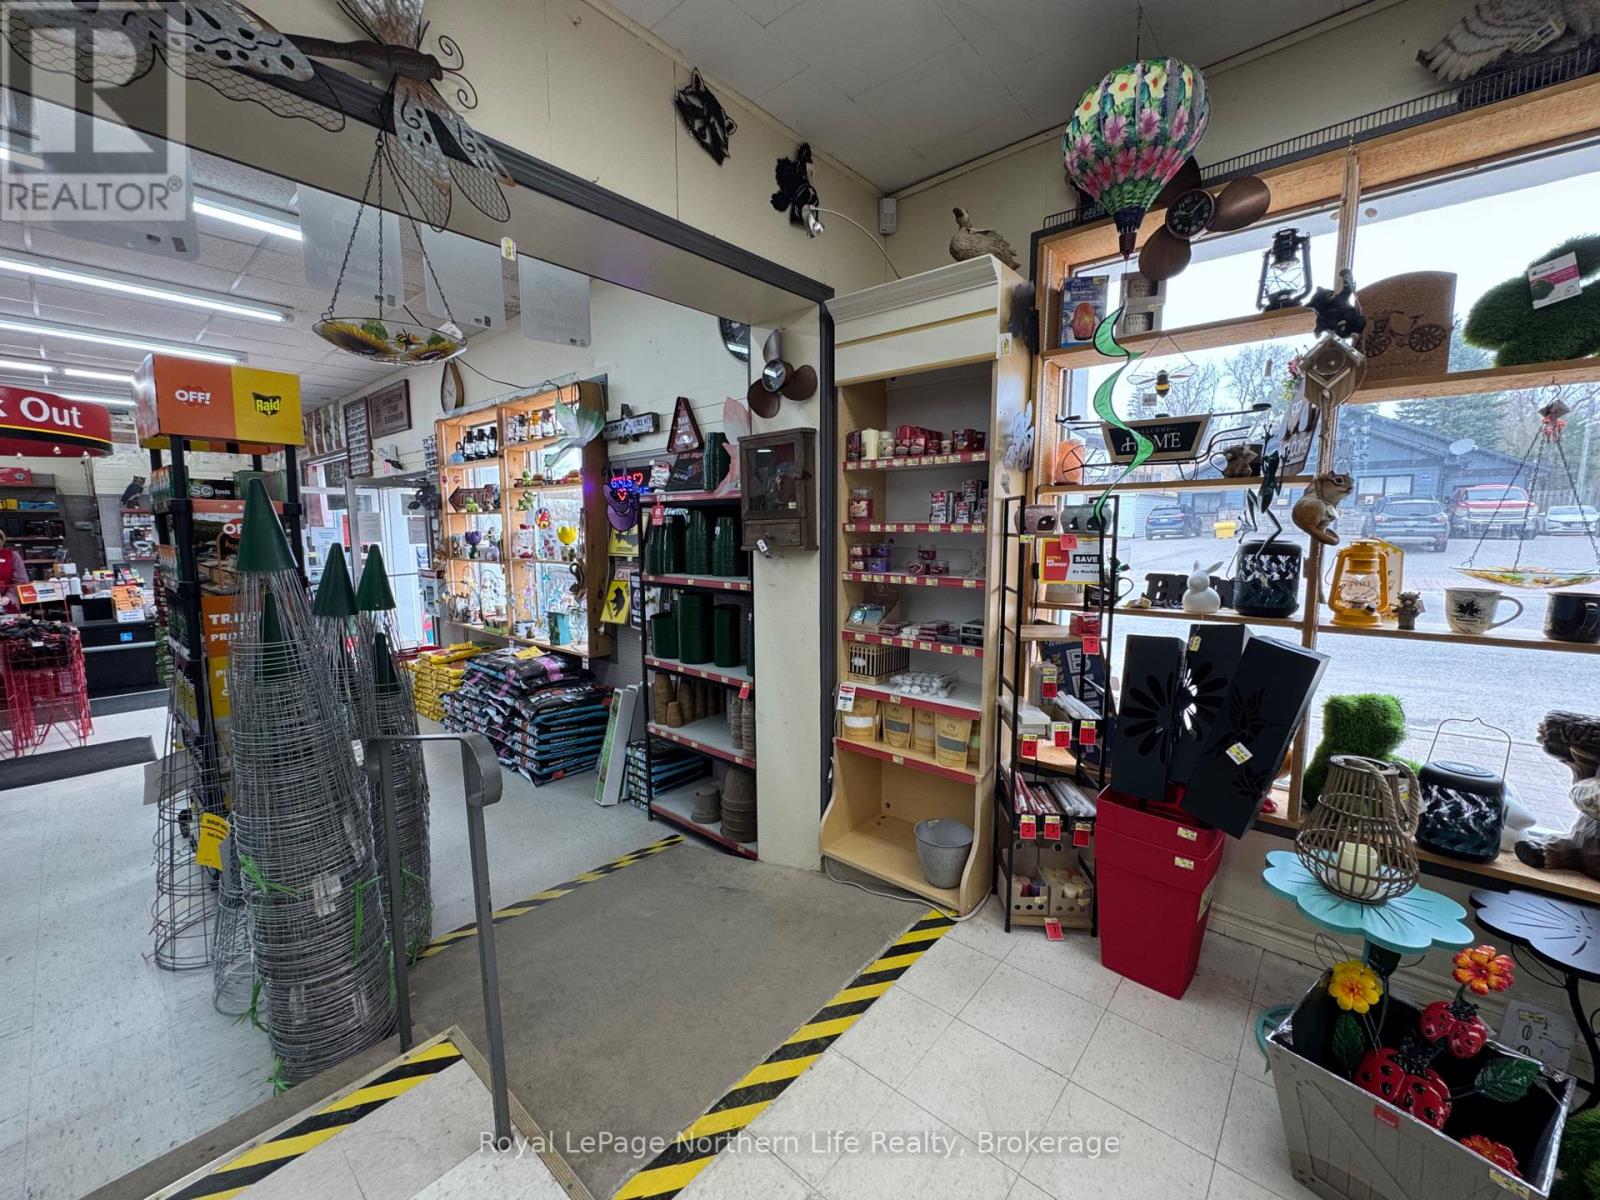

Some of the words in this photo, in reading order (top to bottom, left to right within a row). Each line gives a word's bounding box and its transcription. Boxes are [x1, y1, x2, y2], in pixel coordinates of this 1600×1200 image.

[175, 389, 211, 405] OFF!
[256, 398, 280, 412] Raid
[20, 396, 83, 429] Out
[1120, 432, 1181, 451] HME
